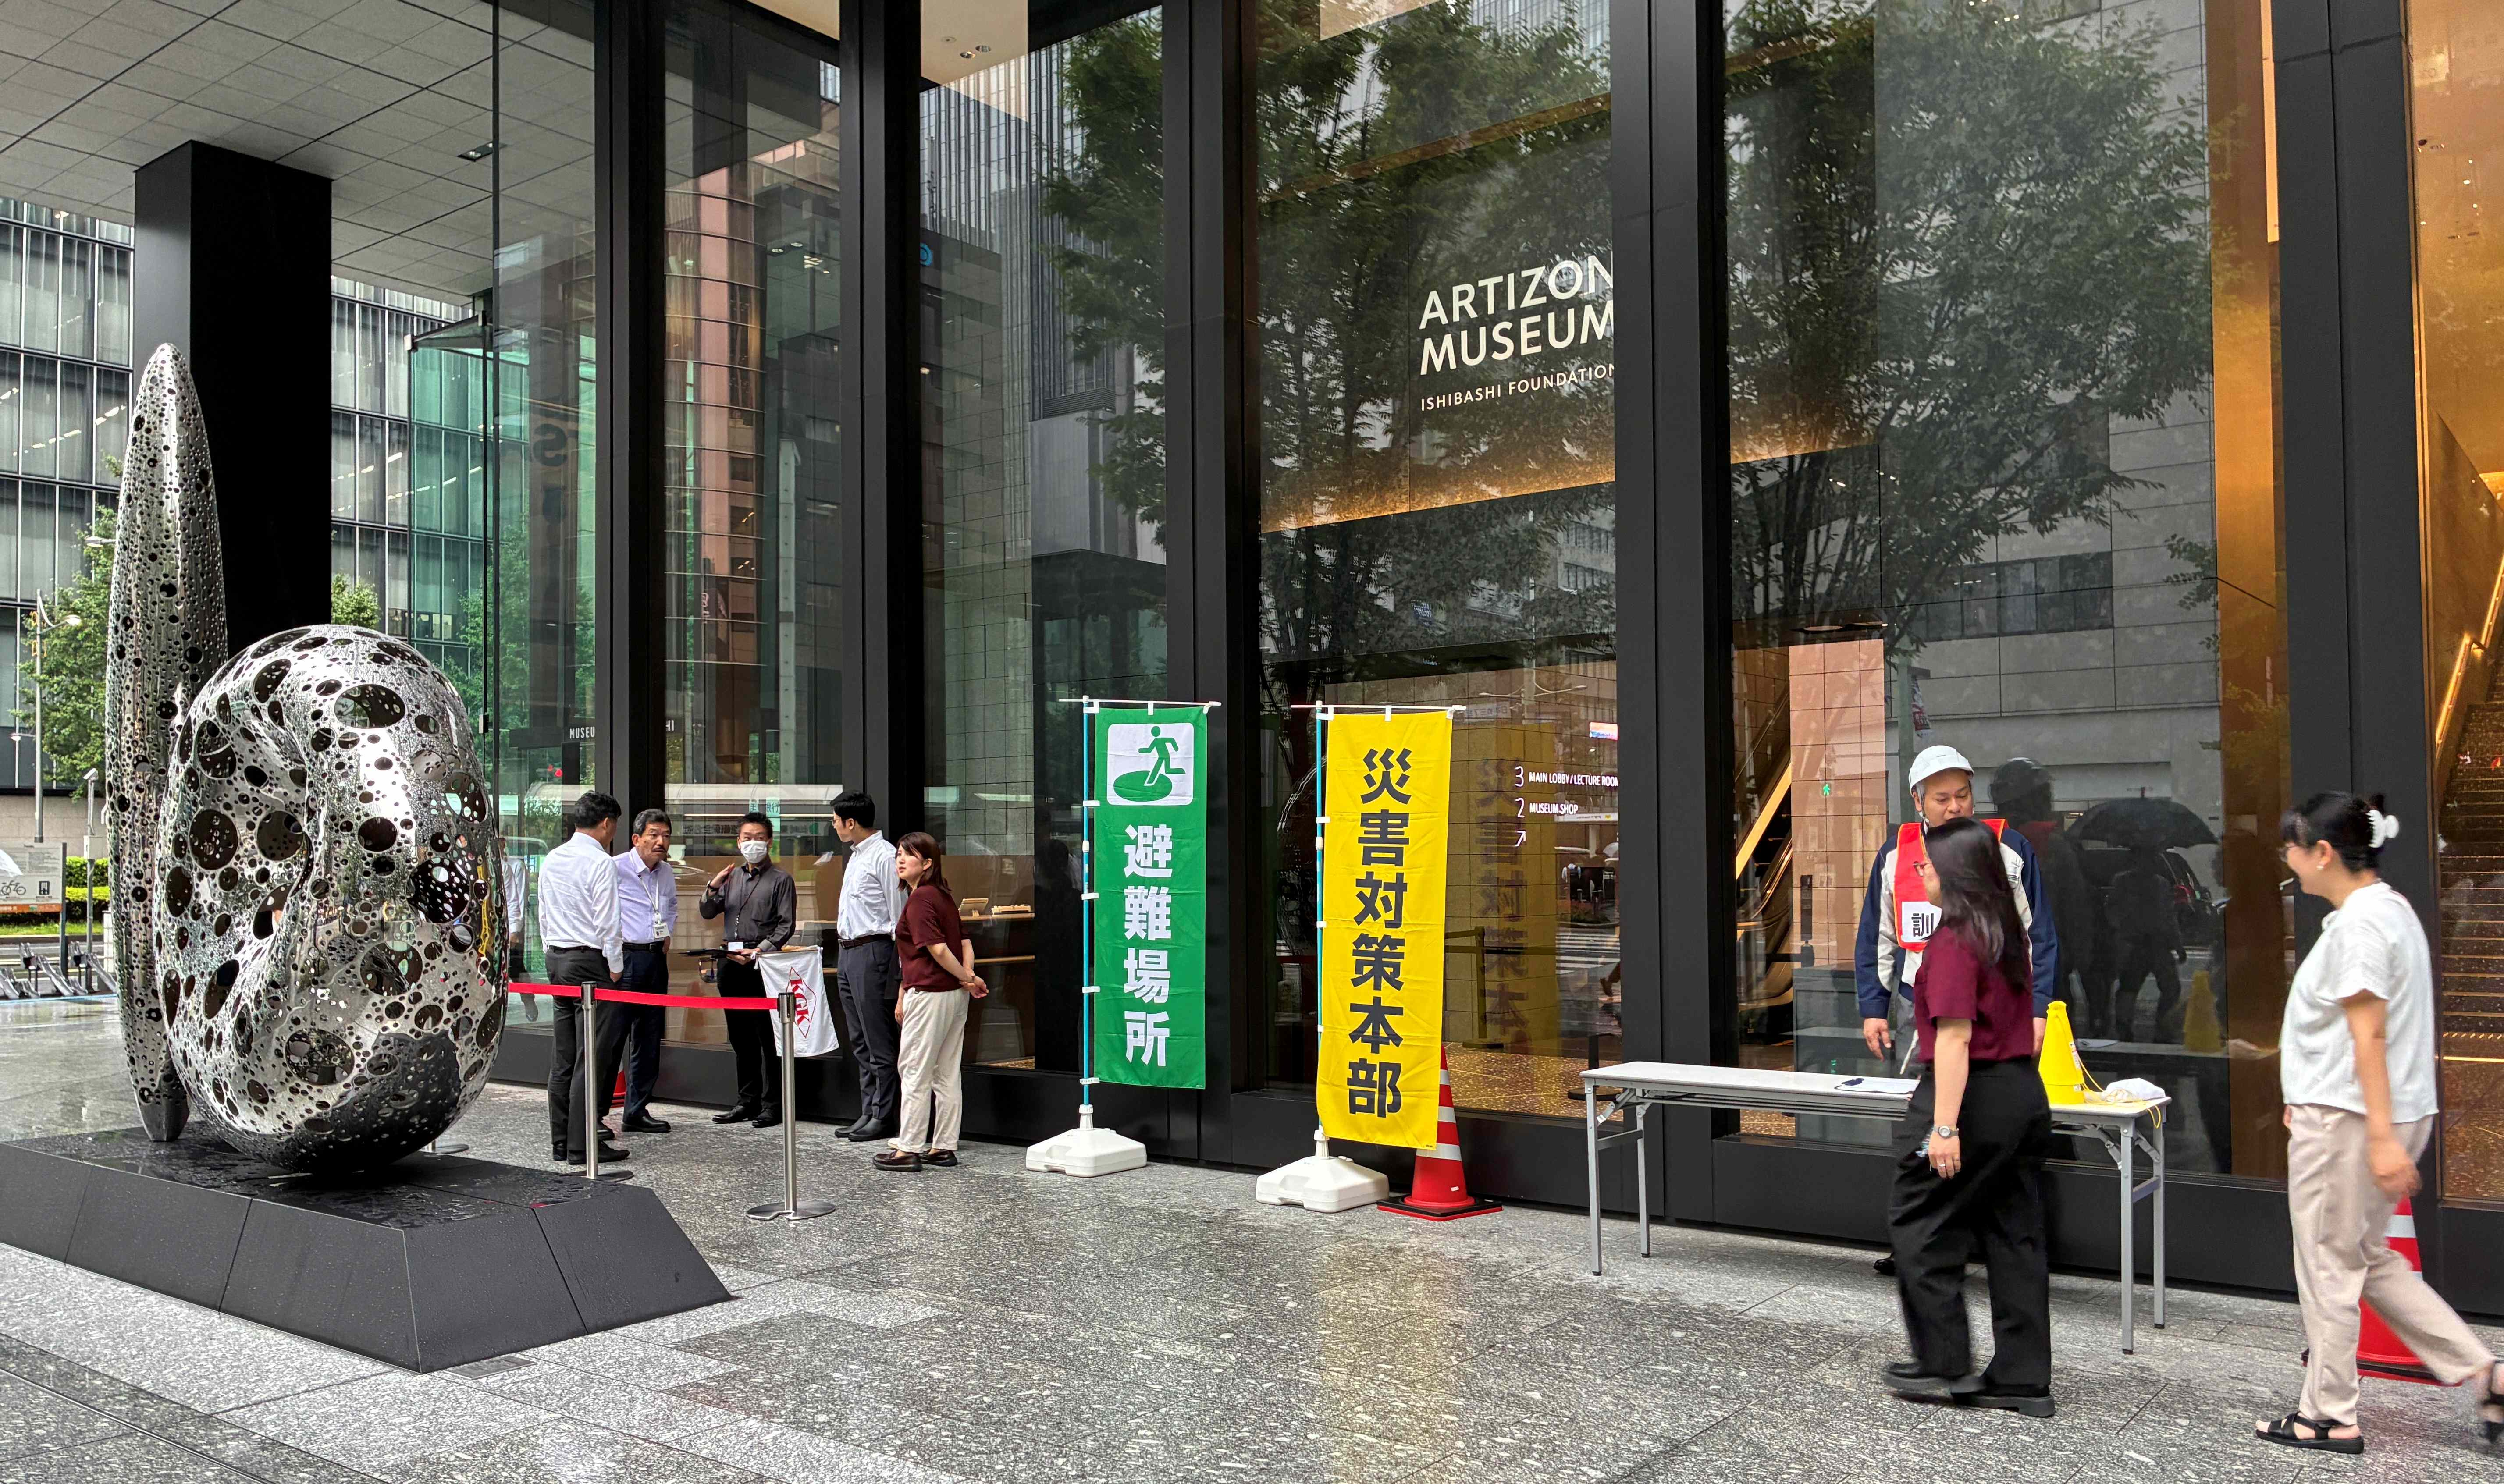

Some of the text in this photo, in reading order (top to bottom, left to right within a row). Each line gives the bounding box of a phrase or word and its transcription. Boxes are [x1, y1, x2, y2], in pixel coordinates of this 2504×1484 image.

[1419, 251, 1613, 330] ARTIZON
[1420, 300, 1614, 376] MUSEUM
[1421, 384, 1501, 411] ISHIBASHI
[569, 726, 595, 739] MUSEU
[1515, 766, 1524, 787] 3
[1529, 772, 1548, 783] MAIN
[1515, 798, 1578, 818] 2 MUSEUM SHOP
[1124, 824, 1173, 1067] 避難場所
[1347, 748, 1411, 1118] 災害対策本部
